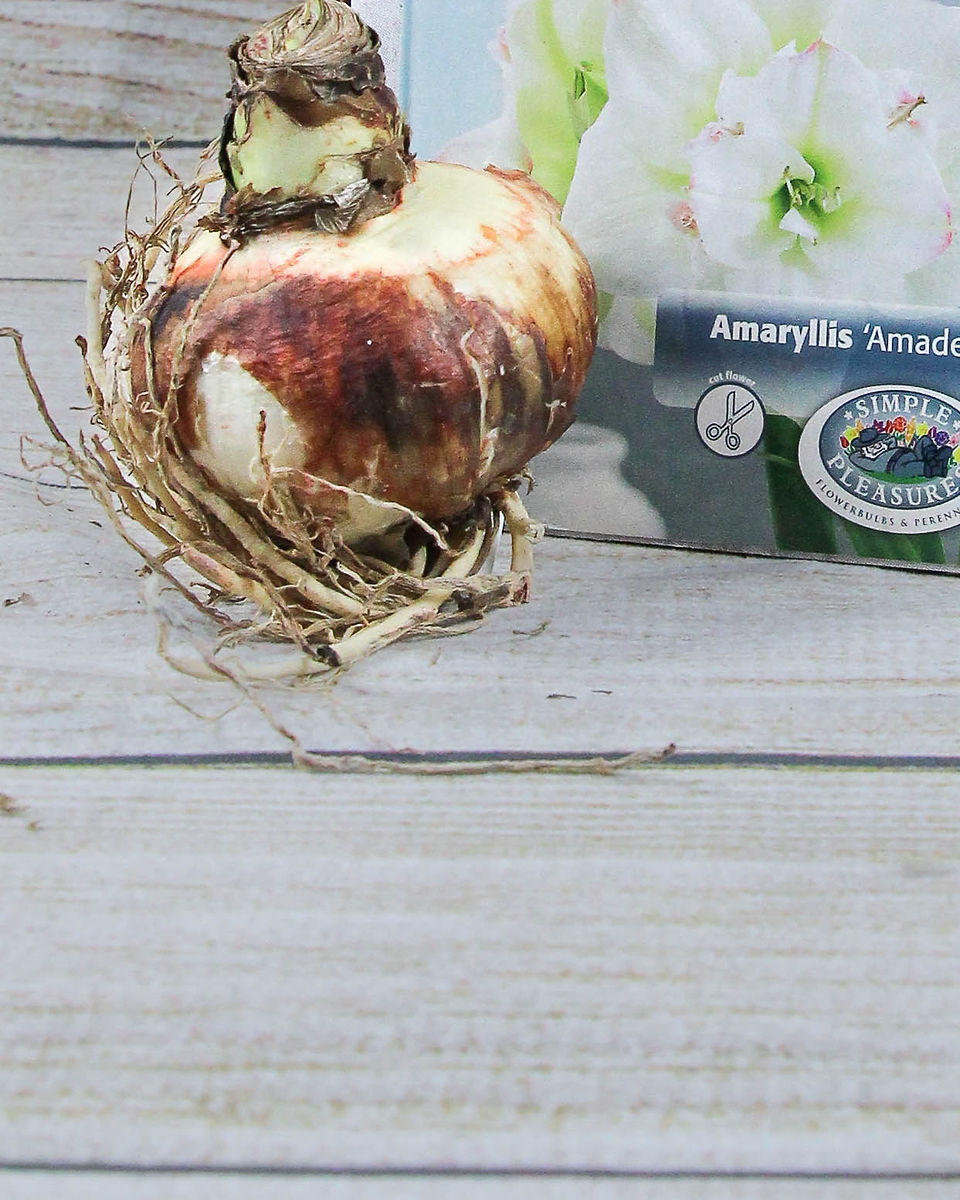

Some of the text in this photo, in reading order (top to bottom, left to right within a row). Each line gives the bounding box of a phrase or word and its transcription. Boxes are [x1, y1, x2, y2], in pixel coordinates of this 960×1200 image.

[709, 314, 853, 353] Amaryllis
[709, 370, 756, 388] cut flower
[855, 394, 952, 427] SIMPLE
[815, 479, 895, 527] FLOWERBULBS
[900, 518, 908, 527] &
